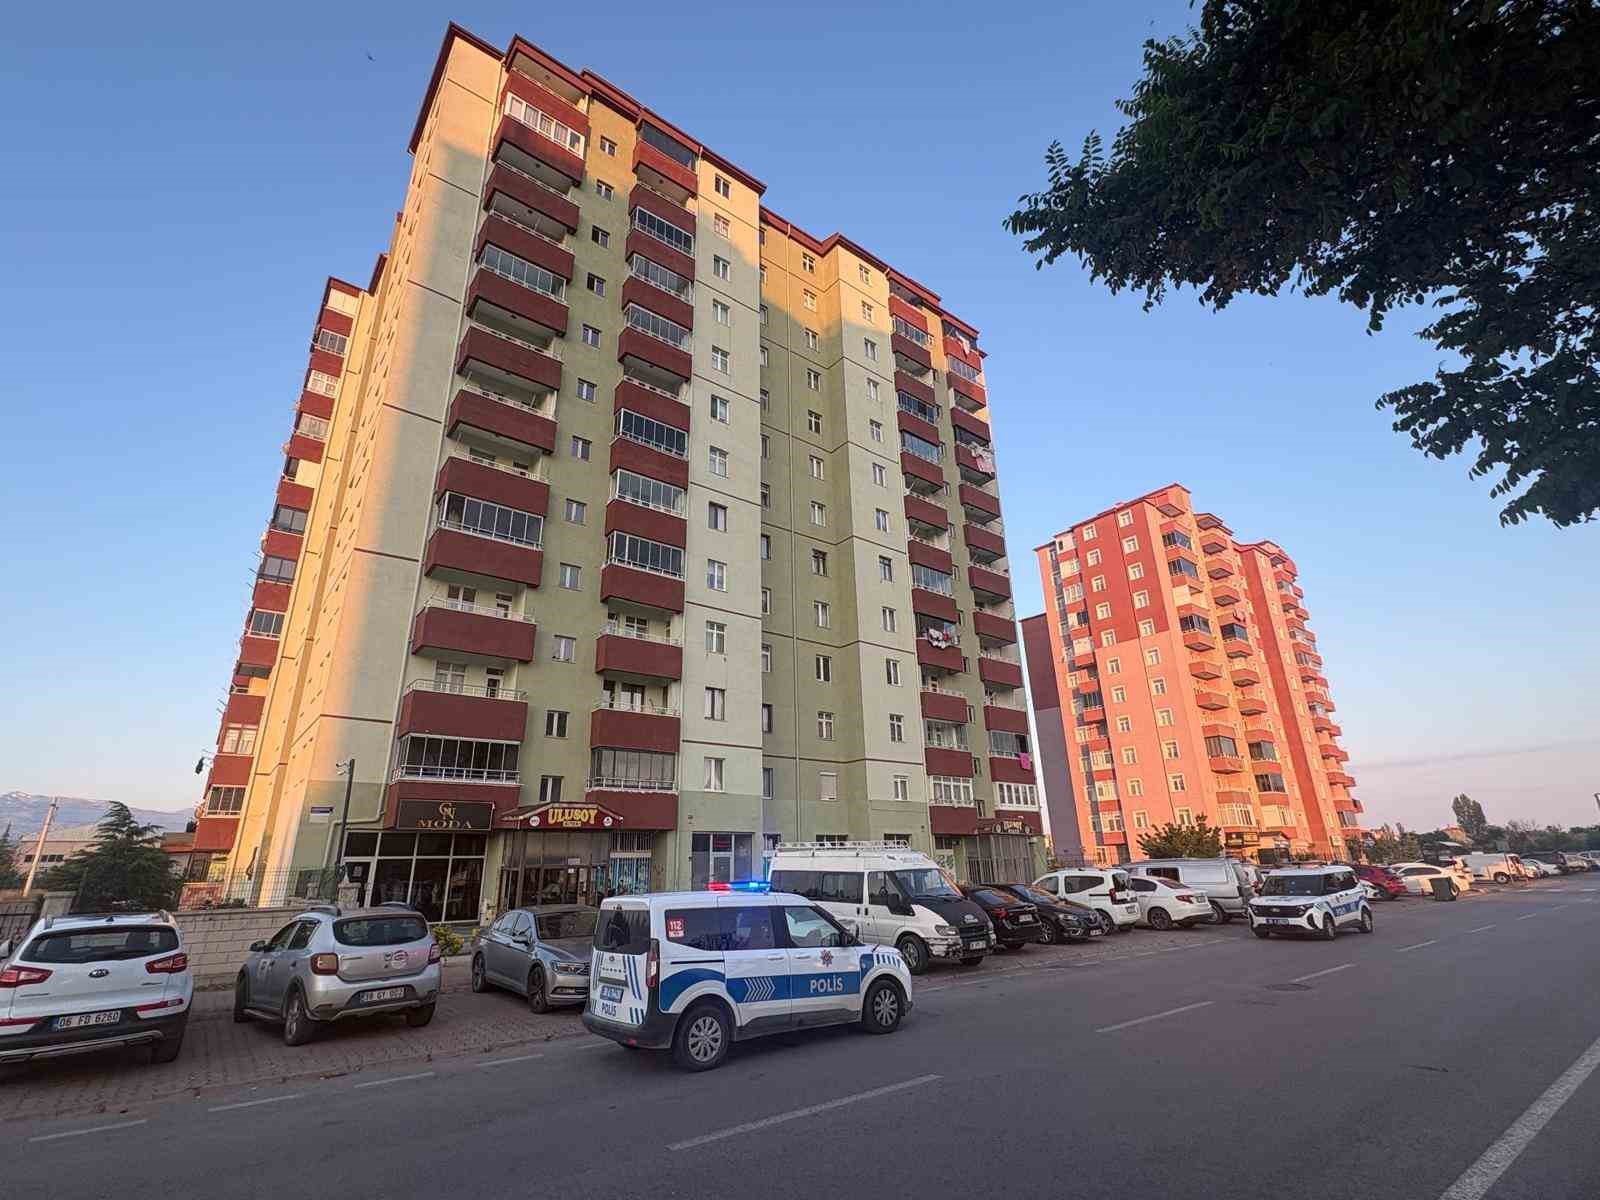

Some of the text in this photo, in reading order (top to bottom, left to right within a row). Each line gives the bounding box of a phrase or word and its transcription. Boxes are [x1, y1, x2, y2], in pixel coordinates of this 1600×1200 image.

[547, 808, 598, 825] ULUSOY
[416, 819, 472, 830] MODA
[669, 920, 683, 931] 112
[810, 974, 844, 993] POLİS
